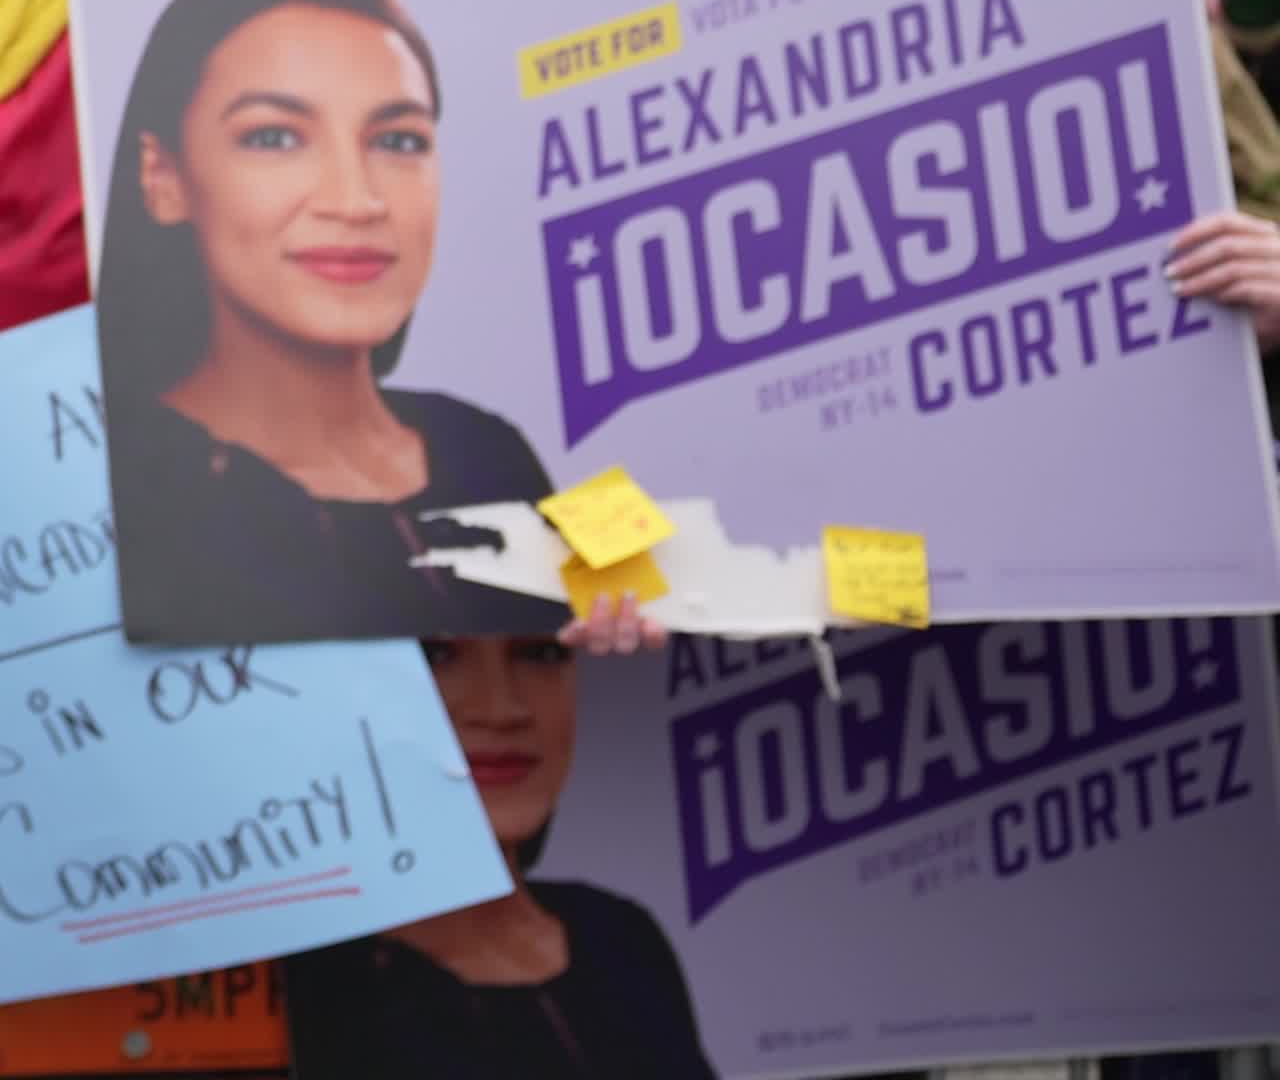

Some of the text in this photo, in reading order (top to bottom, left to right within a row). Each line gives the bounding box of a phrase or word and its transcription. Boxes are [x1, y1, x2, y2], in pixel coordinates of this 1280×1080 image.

[534, 37, 603, 81] VOTE
[610, 17, 664, 61] FOR
[990, 723, 1252, 878] CORTEZ
